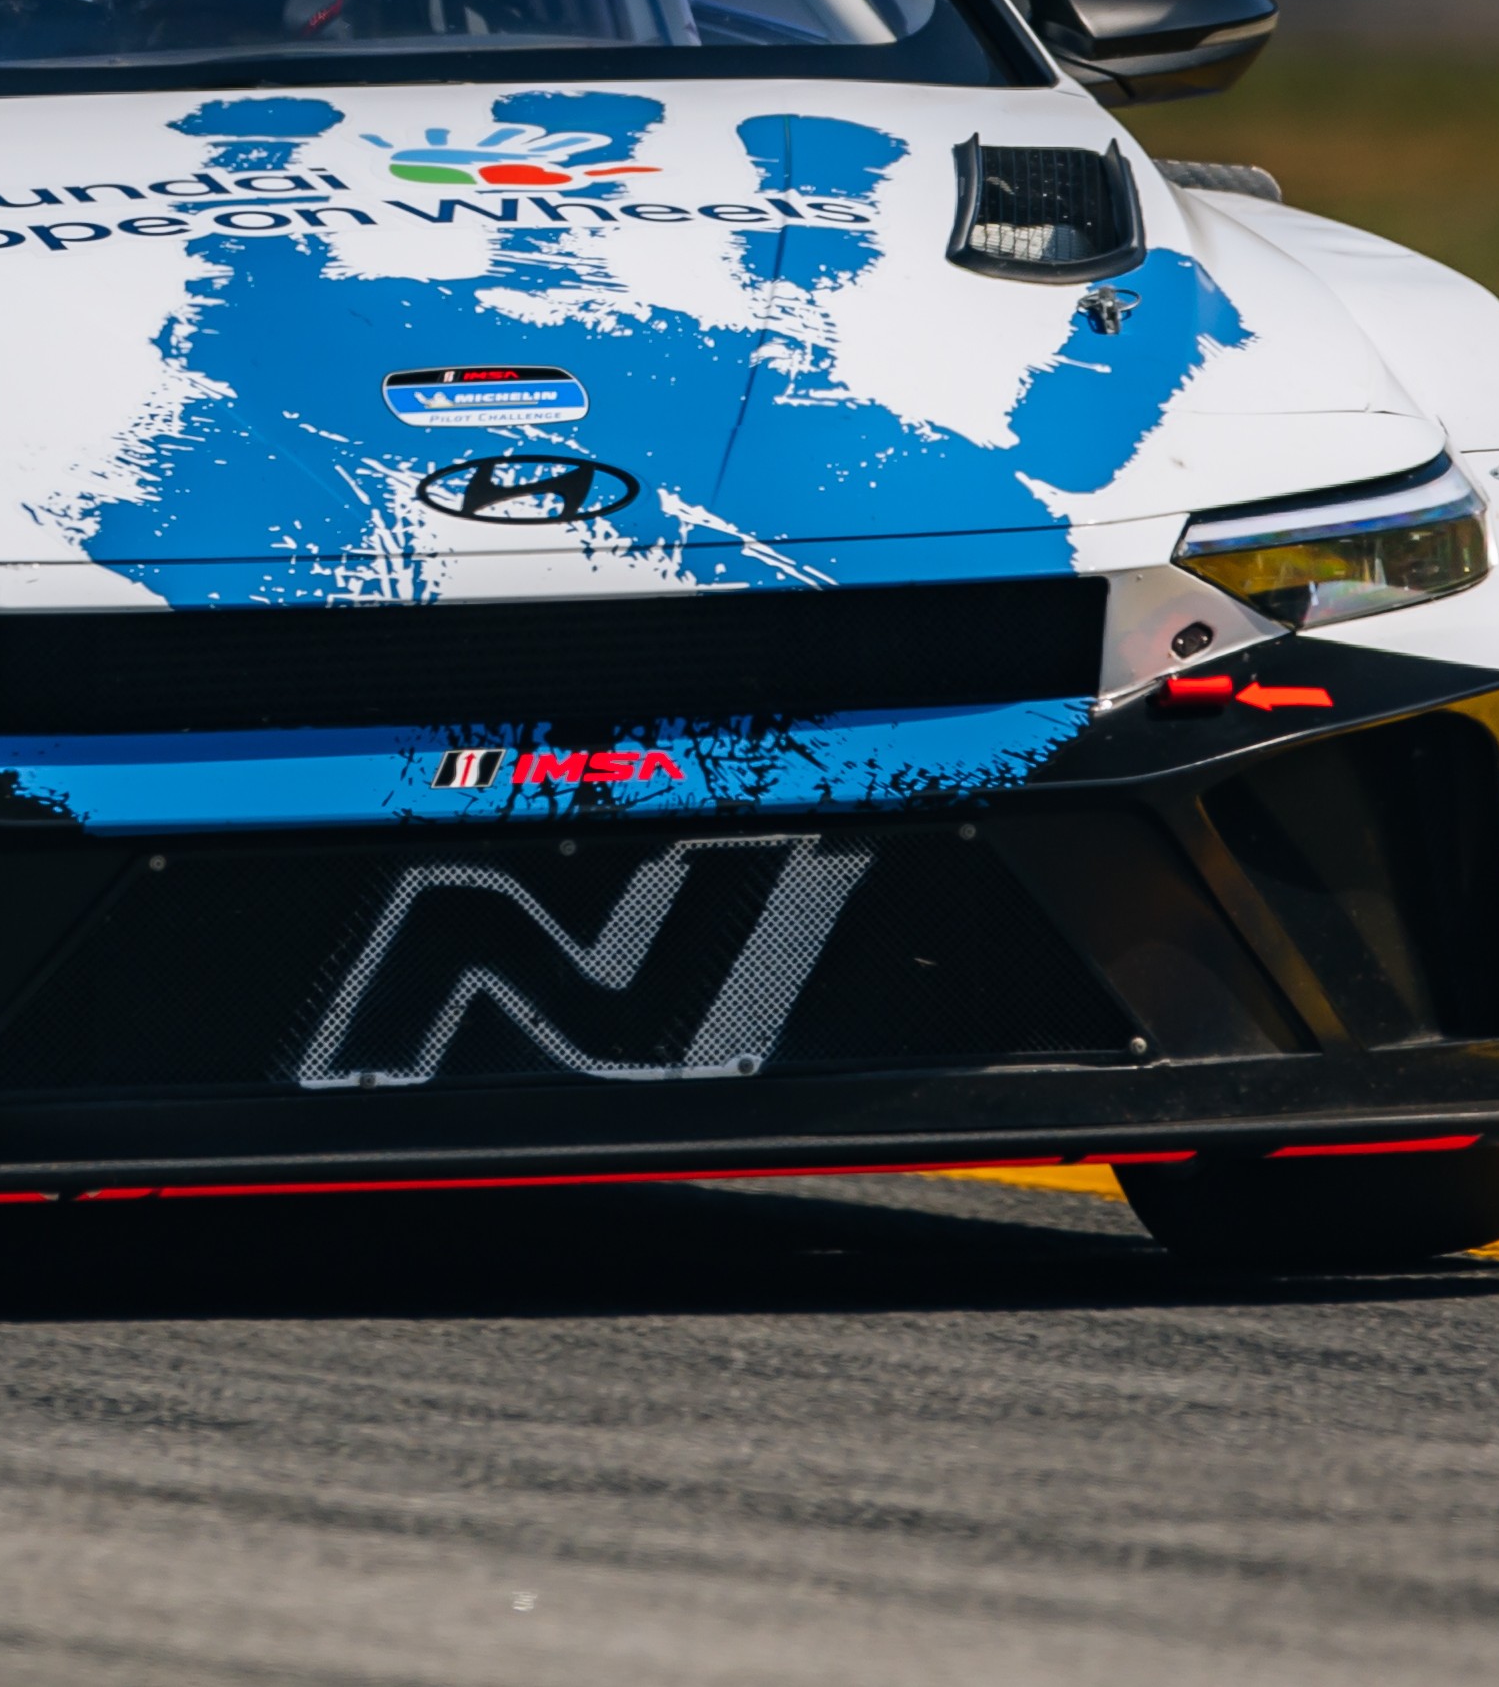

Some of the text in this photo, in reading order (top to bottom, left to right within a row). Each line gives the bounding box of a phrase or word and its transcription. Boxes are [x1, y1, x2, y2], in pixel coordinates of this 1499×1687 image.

[211, 204, 379, 233] on
[383, 191, 876, 225] Wheels
[463, 370, 519, 381] IMSA
[454, 390, 559, 404] MICHELIN
[429, 411, 563, 424] PILOT CHALLENGE
[511, 749, 686, 785] IMSA
